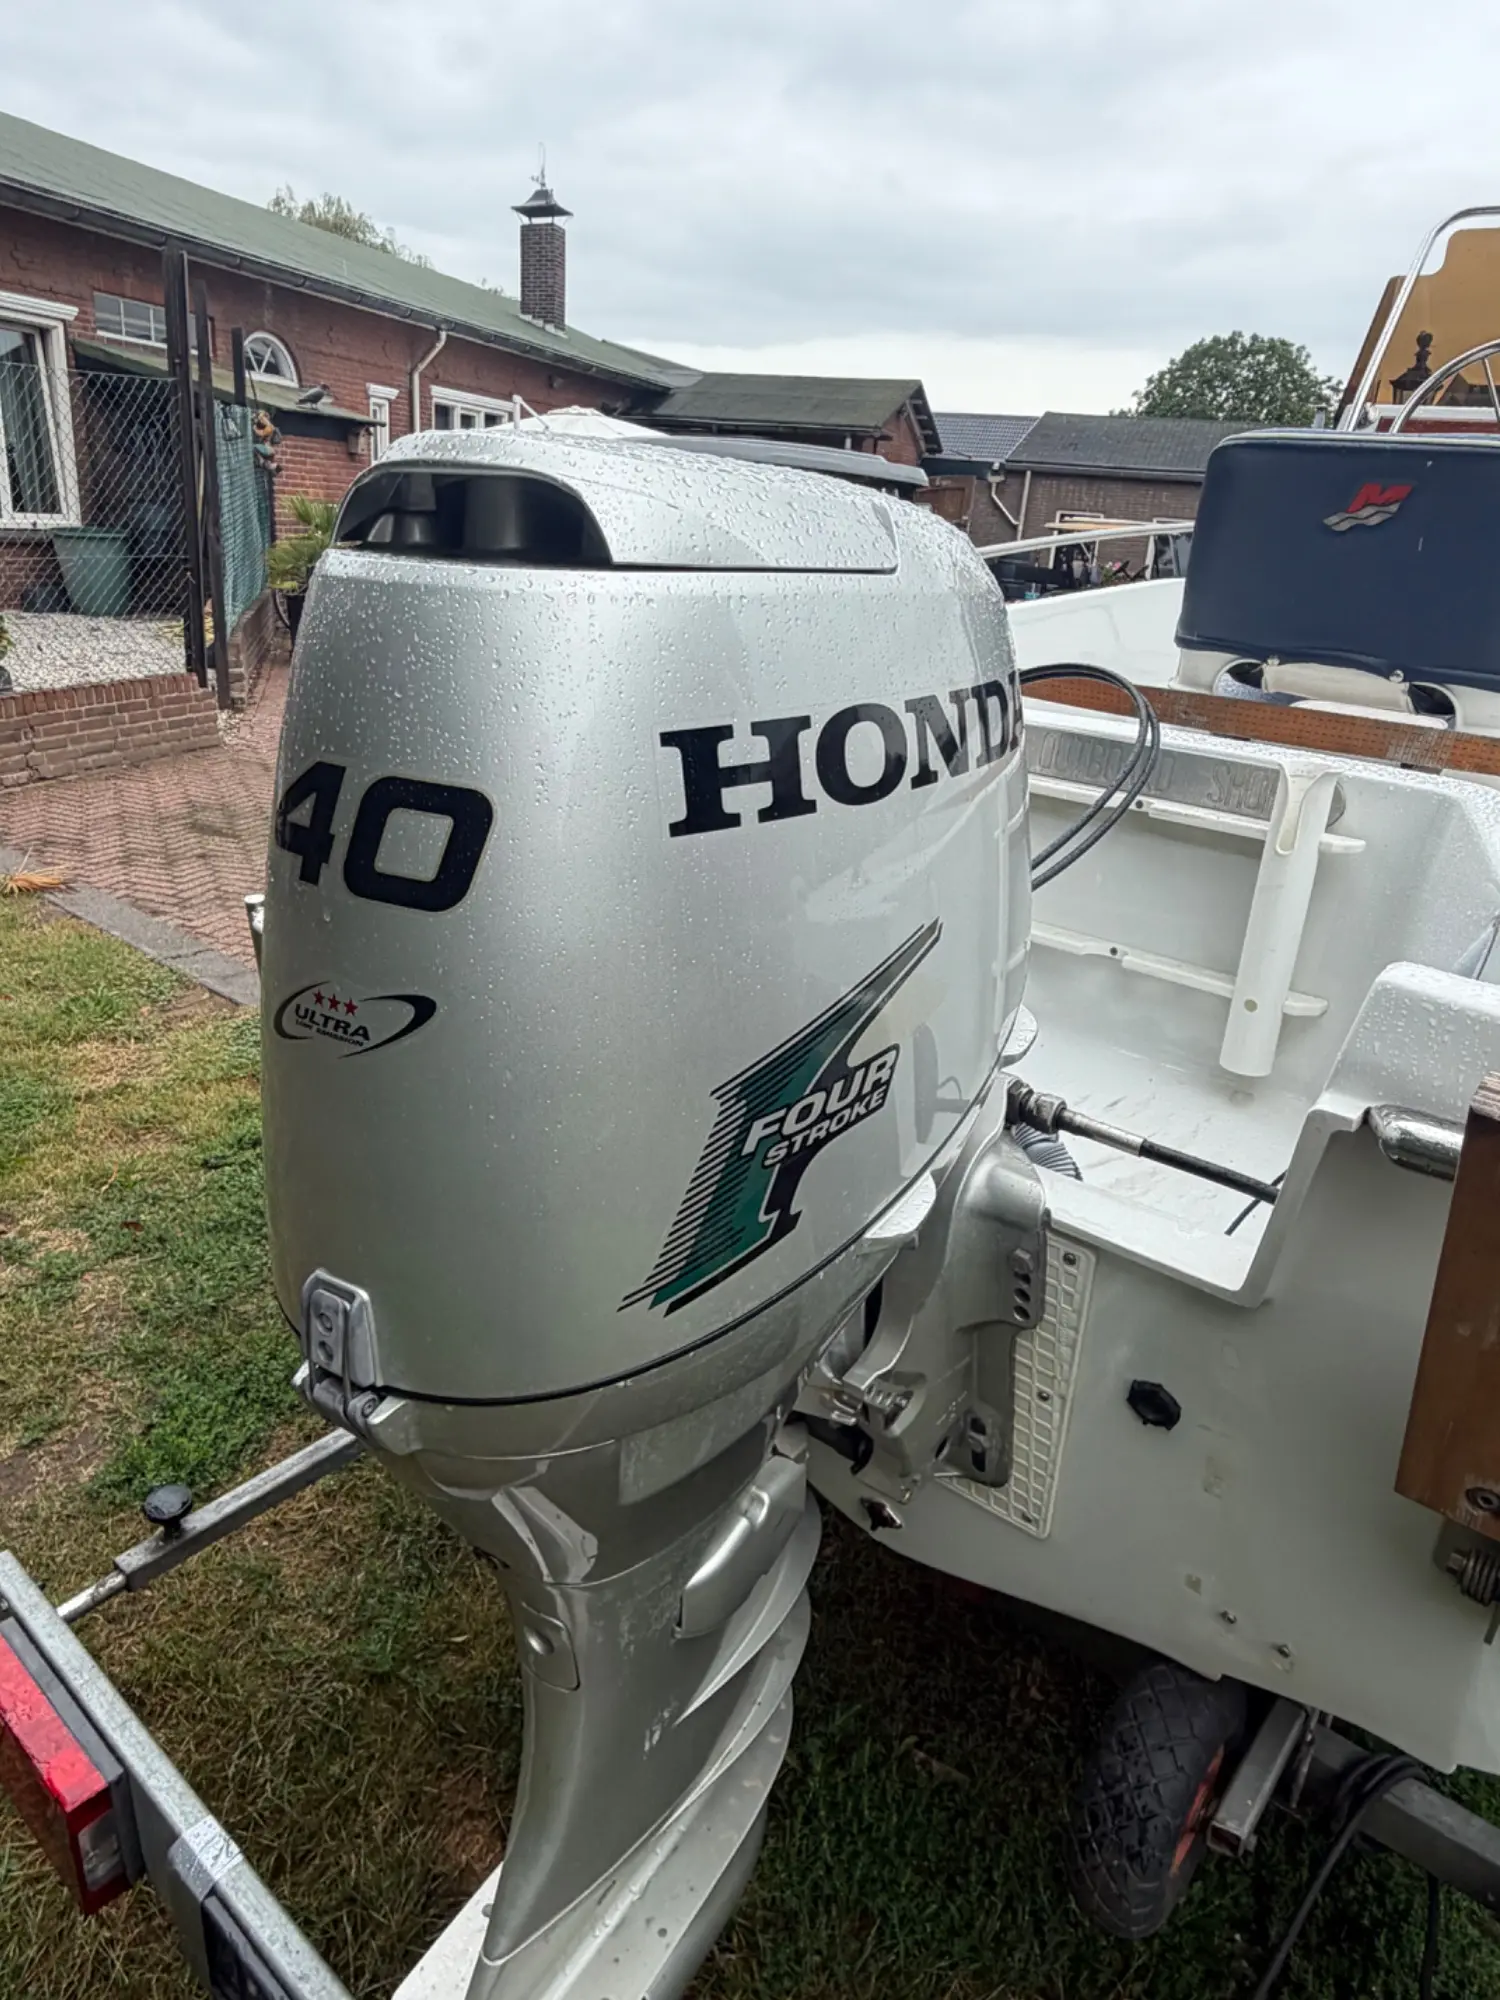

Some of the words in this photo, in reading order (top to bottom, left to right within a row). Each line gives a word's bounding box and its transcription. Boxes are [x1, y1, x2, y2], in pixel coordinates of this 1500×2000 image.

[274, 760, 494, 913] 40
[295, 1003, 371, 1042] ULTRA
[740, 1049, 898, 1157] FOUR
[763, 1084, 888, 1167] STROKE
